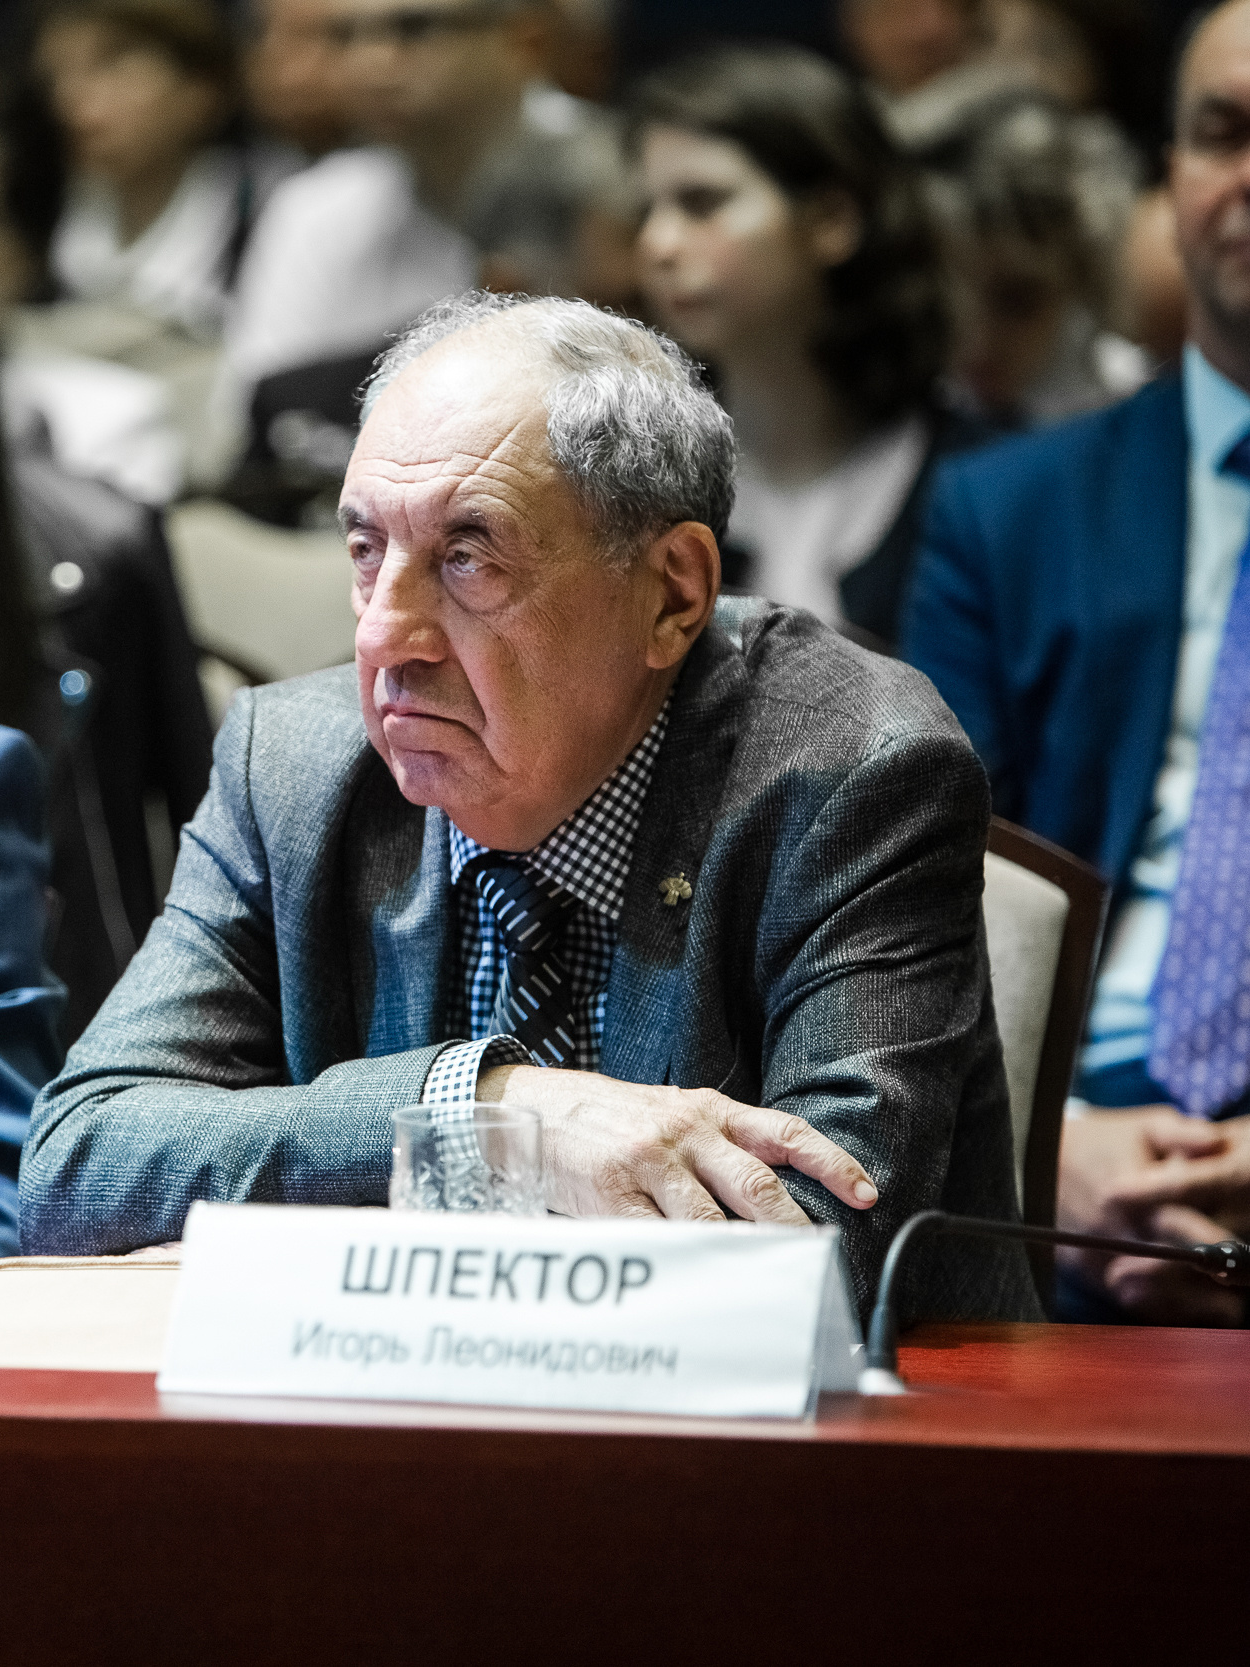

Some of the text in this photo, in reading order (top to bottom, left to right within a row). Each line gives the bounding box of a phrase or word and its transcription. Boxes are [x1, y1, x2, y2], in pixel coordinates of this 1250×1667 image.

[340, 1245, 653, 1305] ШПЕКТОР
[291, 1320, 680, 1378] Игорь Леонидович
